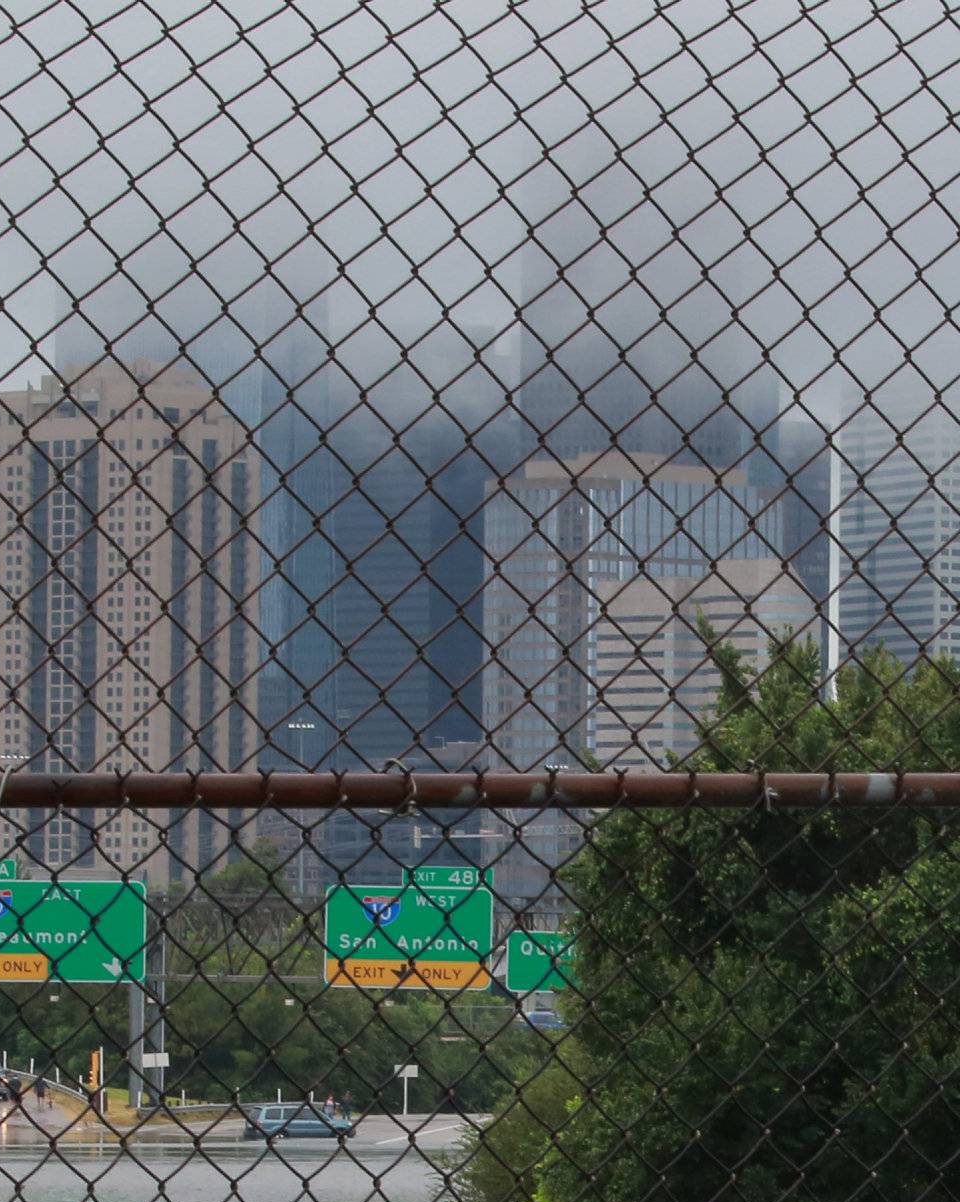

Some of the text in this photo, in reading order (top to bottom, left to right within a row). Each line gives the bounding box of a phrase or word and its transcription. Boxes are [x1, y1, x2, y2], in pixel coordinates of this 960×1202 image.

[411, 871, 437, 882] XIT
[415, 895, 457, 908] WEST
[339, 933, 479, 951] San Antonio
[2, 960, 43, 973] ONLY
[352, 966, 462, 980] EXIT ONLY
